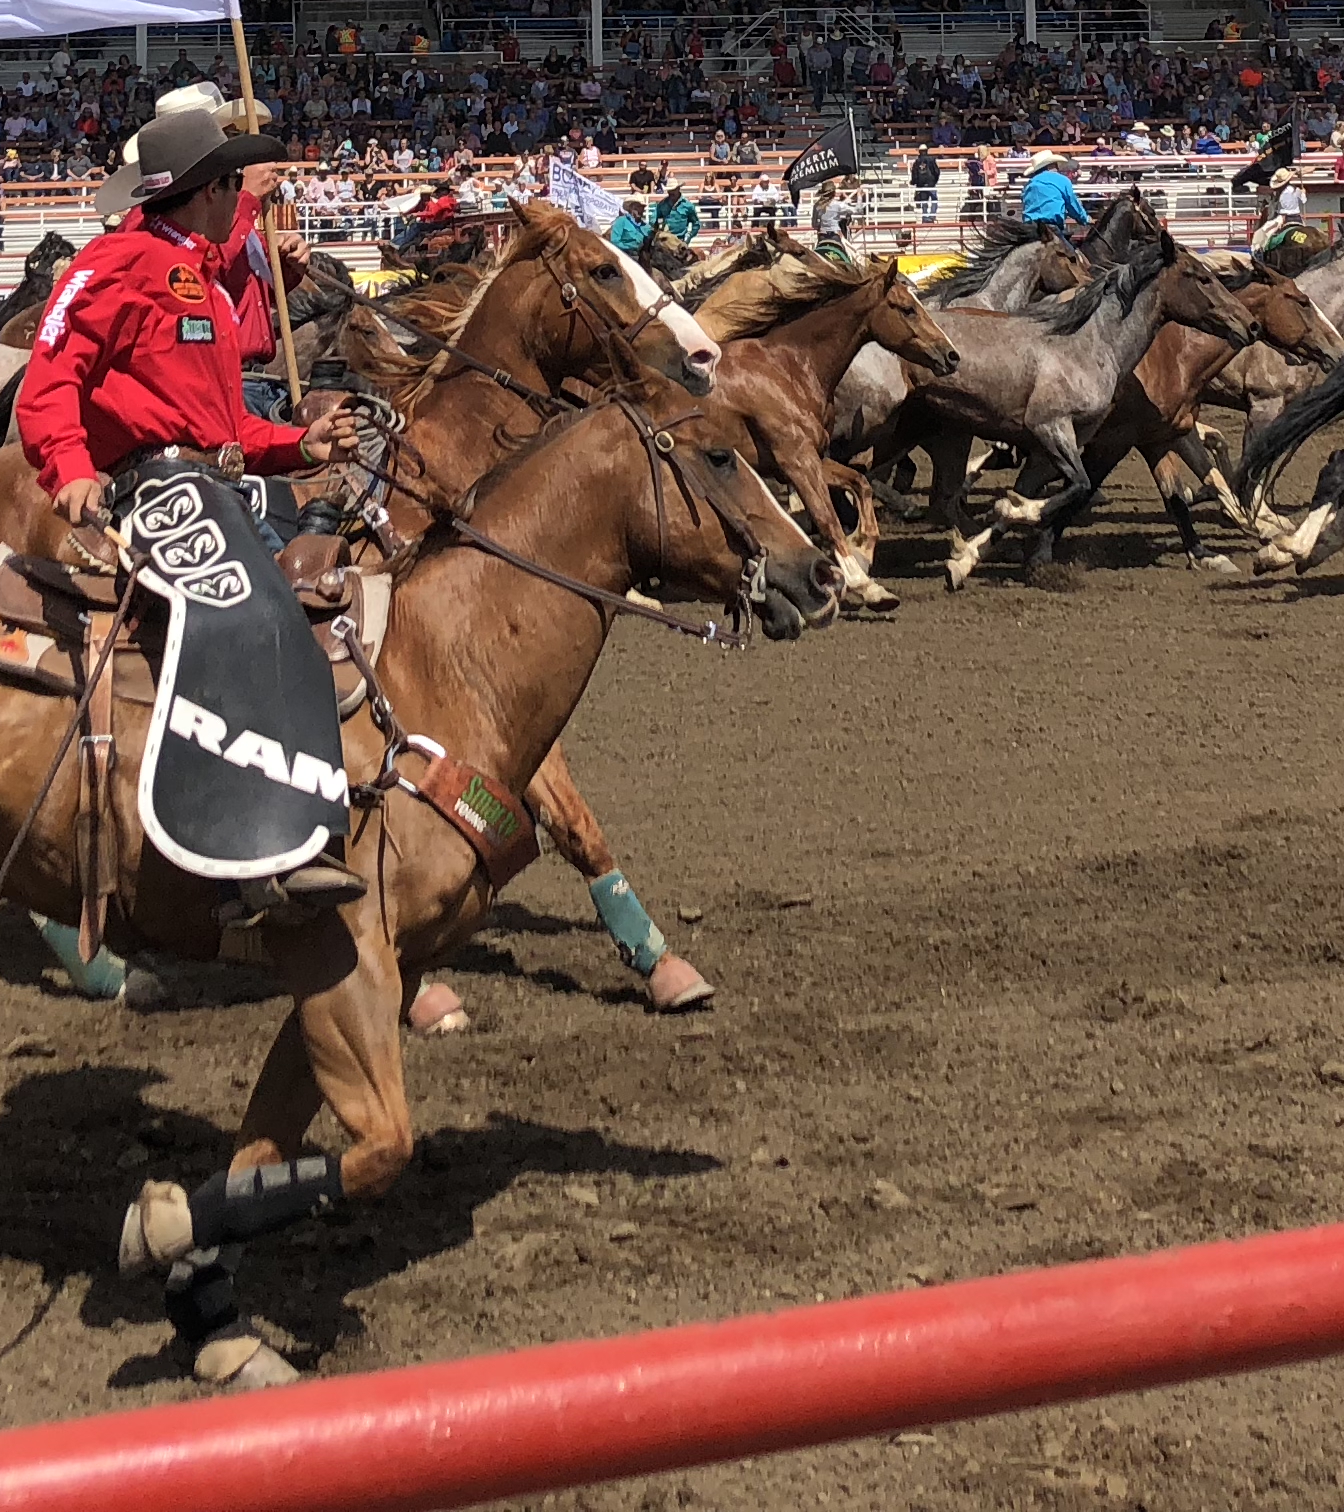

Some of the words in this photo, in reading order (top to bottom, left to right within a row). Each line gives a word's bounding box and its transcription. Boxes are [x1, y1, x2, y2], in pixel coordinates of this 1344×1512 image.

[790, 157, 839, 185] PREMIUM
[791, 148, 835, 177] ALBERTA
[169, 694, 350, 808] RAM
